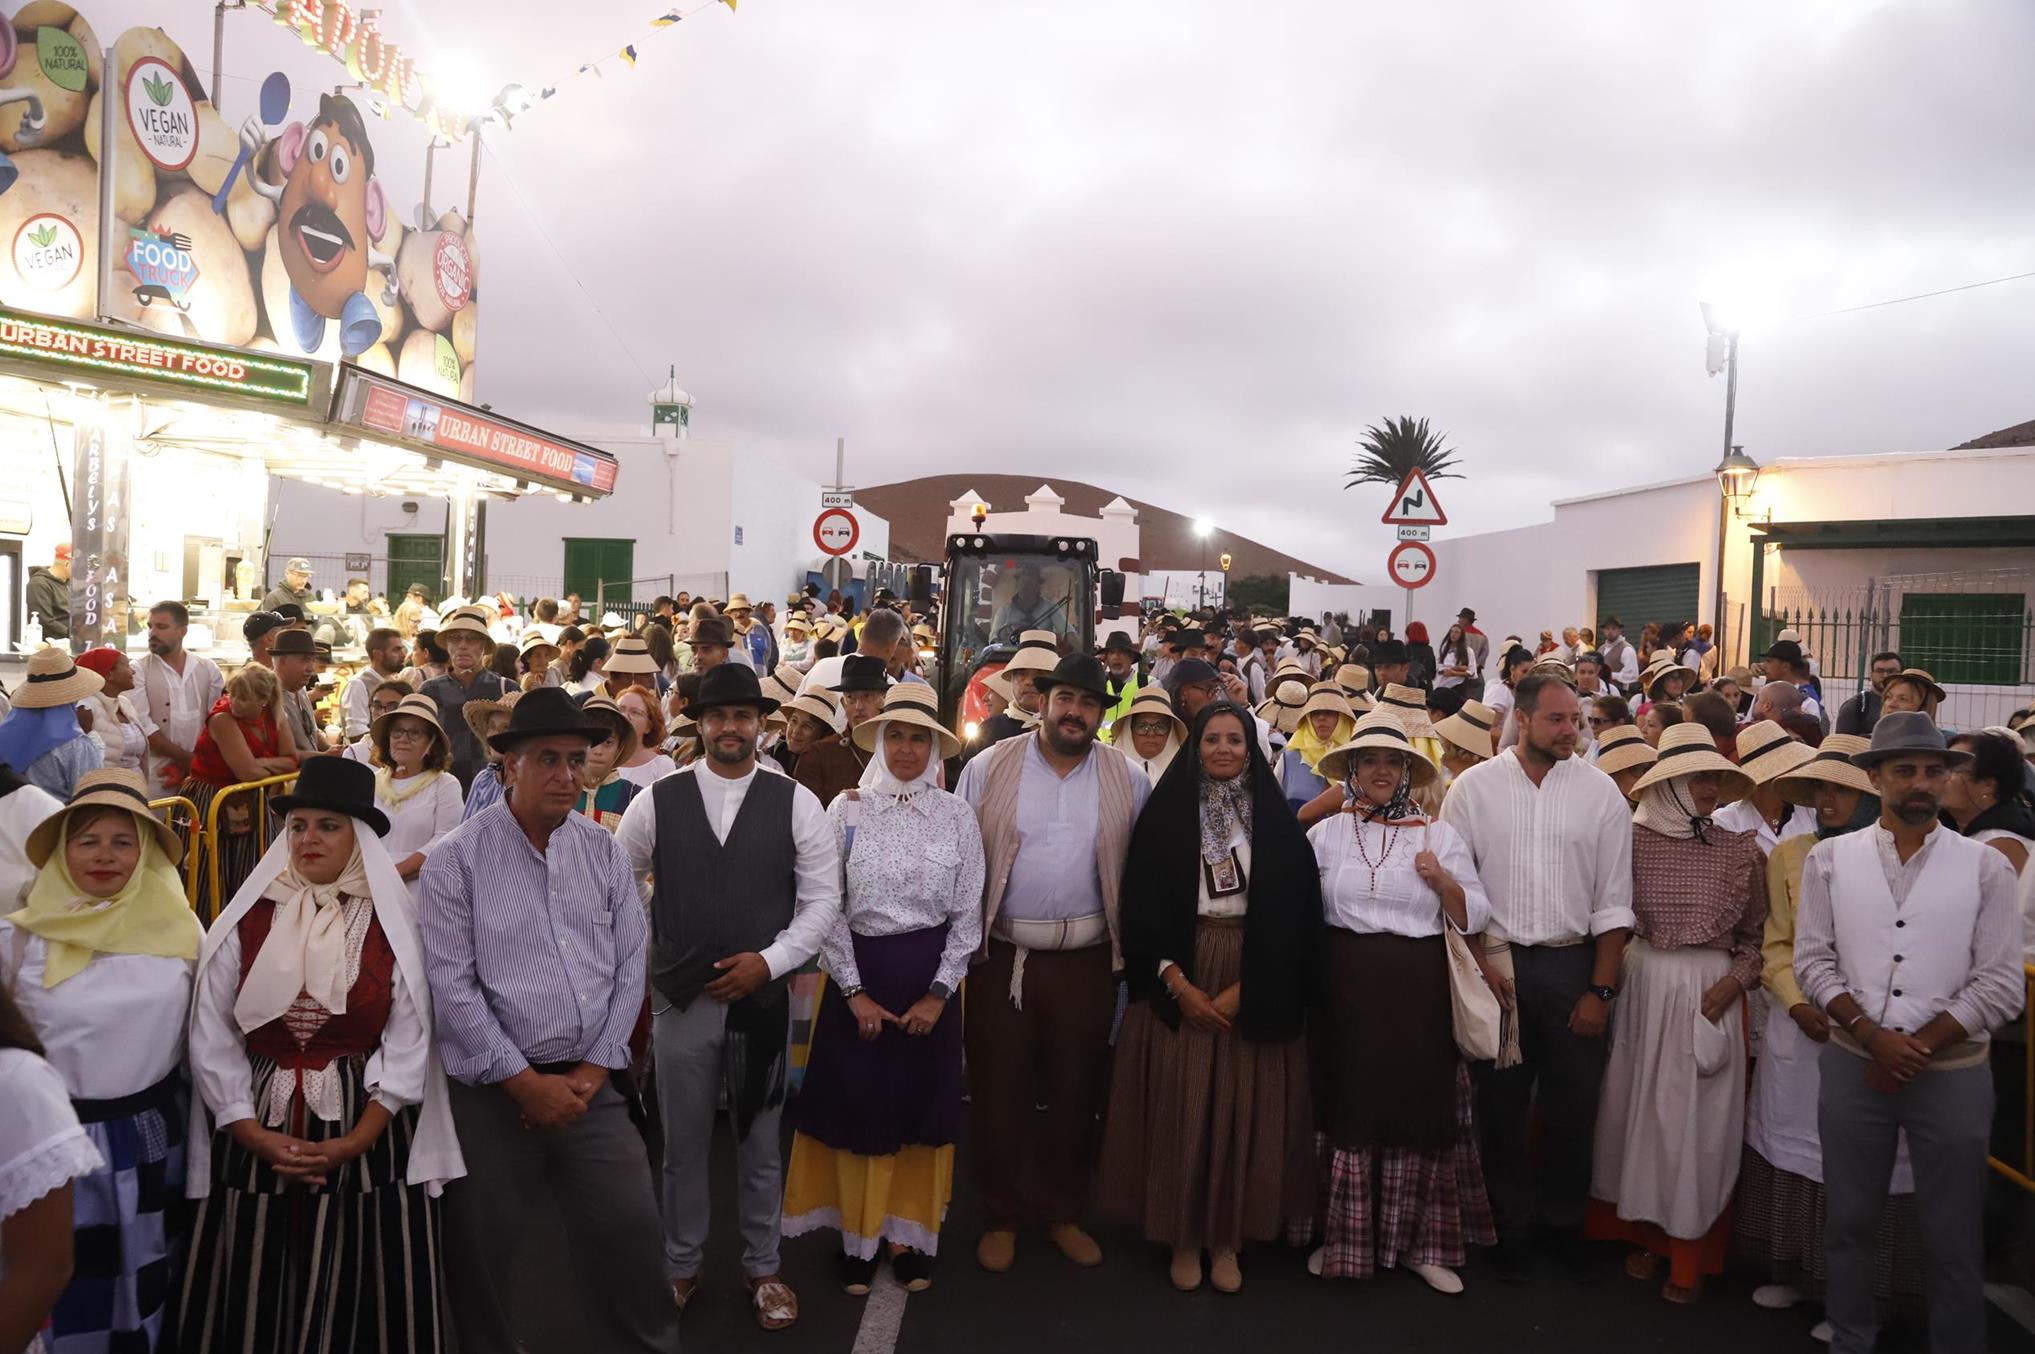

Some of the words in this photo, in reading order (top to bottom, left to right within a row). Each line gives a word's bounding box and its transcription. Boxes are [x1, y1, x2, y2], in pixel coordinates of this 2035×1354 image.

[45, 57, 86, 71] NATURAL
[53, 46, 78, 58] 100%
[139, 108, 189, 135] VEGAN
[153, 135, 183, 148] NATURAL
[24, 243, 73, 269] VEGAN
[133, 240, 192, 272] FOOD
[139, 264, 189, 288] TRUCK
[437, 249, 470, 293] ORGANIC
[0, 323, 87, 354] URBAN
[92, 335, 176, 368] STREET
[182, 357, 245, 379] FOOD
[440, 415, 490, 448] URBAN
[491, 431, 541, 460] STREET
[541, 448, 574, 473] FOOD
[85, 570, 97, 625] FOOD
